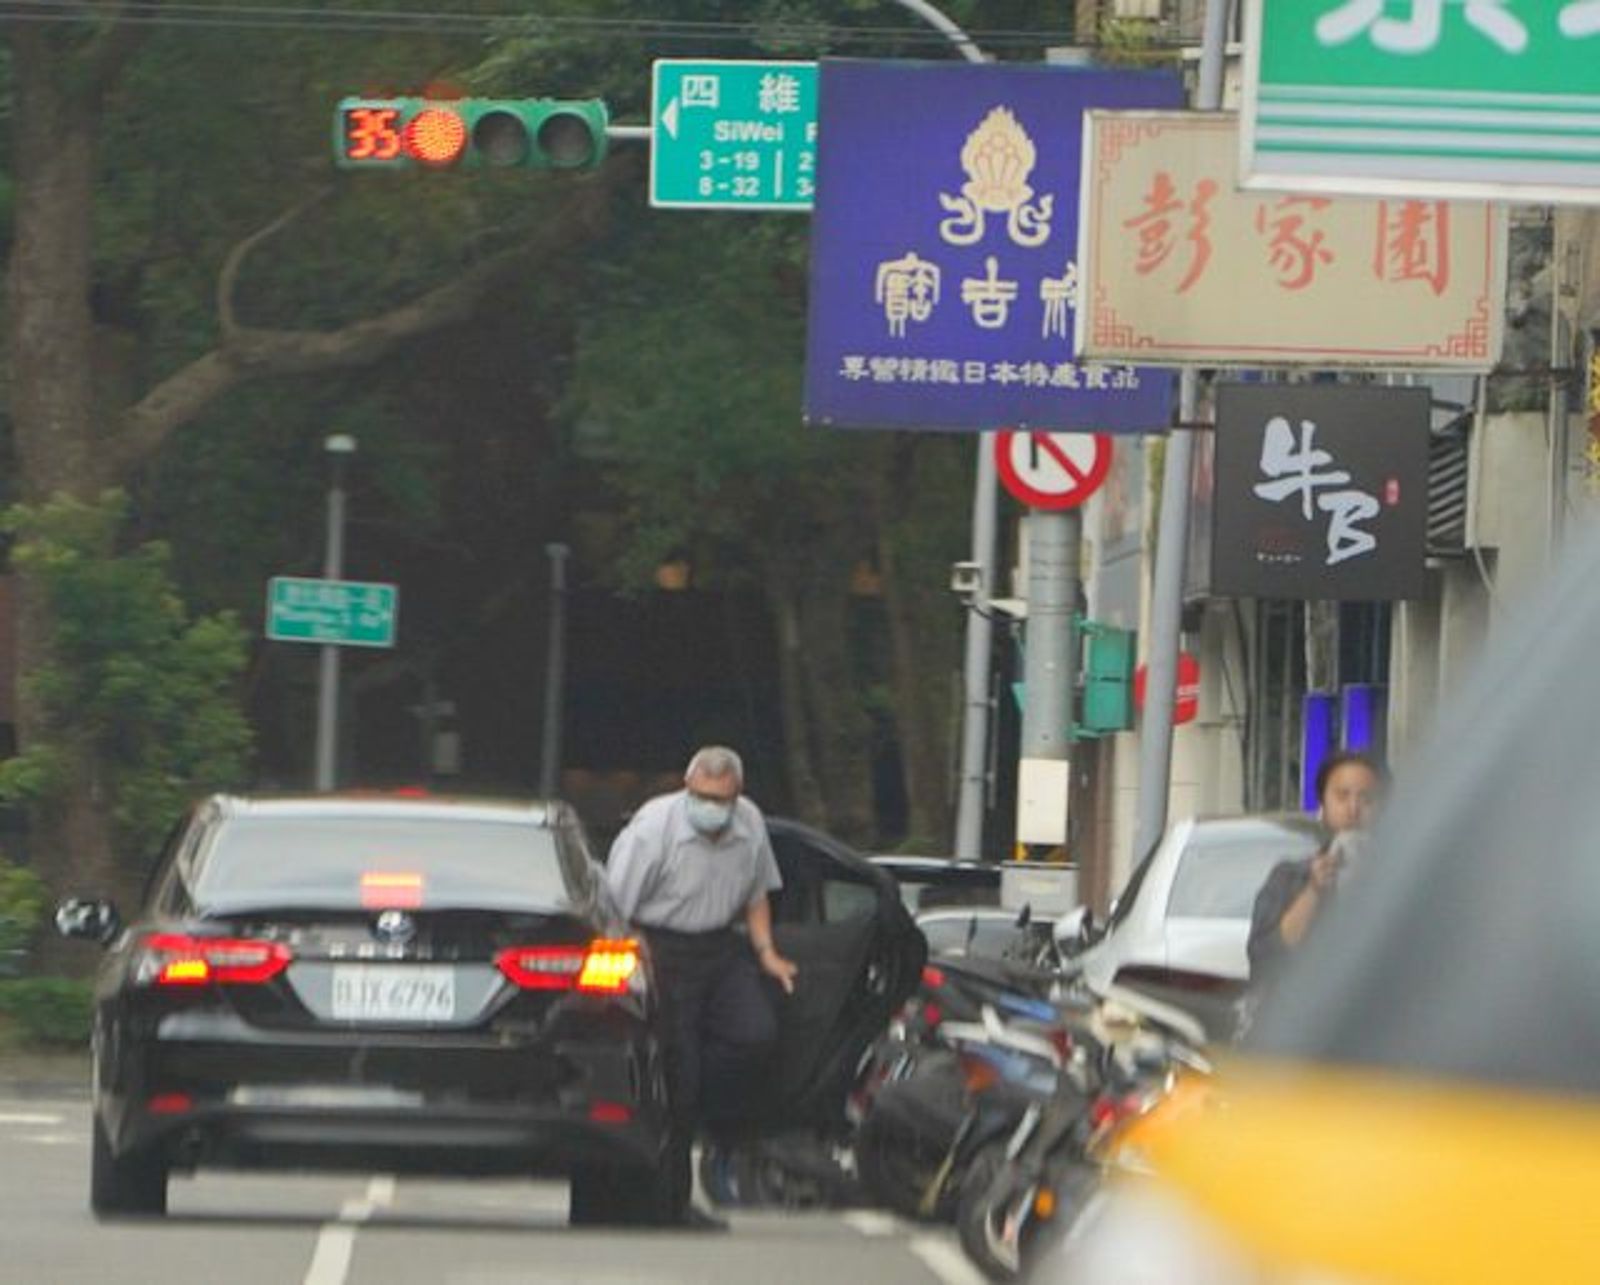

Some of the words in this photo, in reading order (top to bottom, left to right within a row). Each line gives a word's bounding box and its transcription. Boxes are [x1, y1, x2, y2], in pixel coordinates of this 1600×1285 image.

[681, 73, 801, 113] 四維
[348, 109, 401, 159] 35
[714, 119, 784, 142] SiWei
[700, 150, 760, 171] 3-19
[1122, 171, 1450, 296] 彭家園
